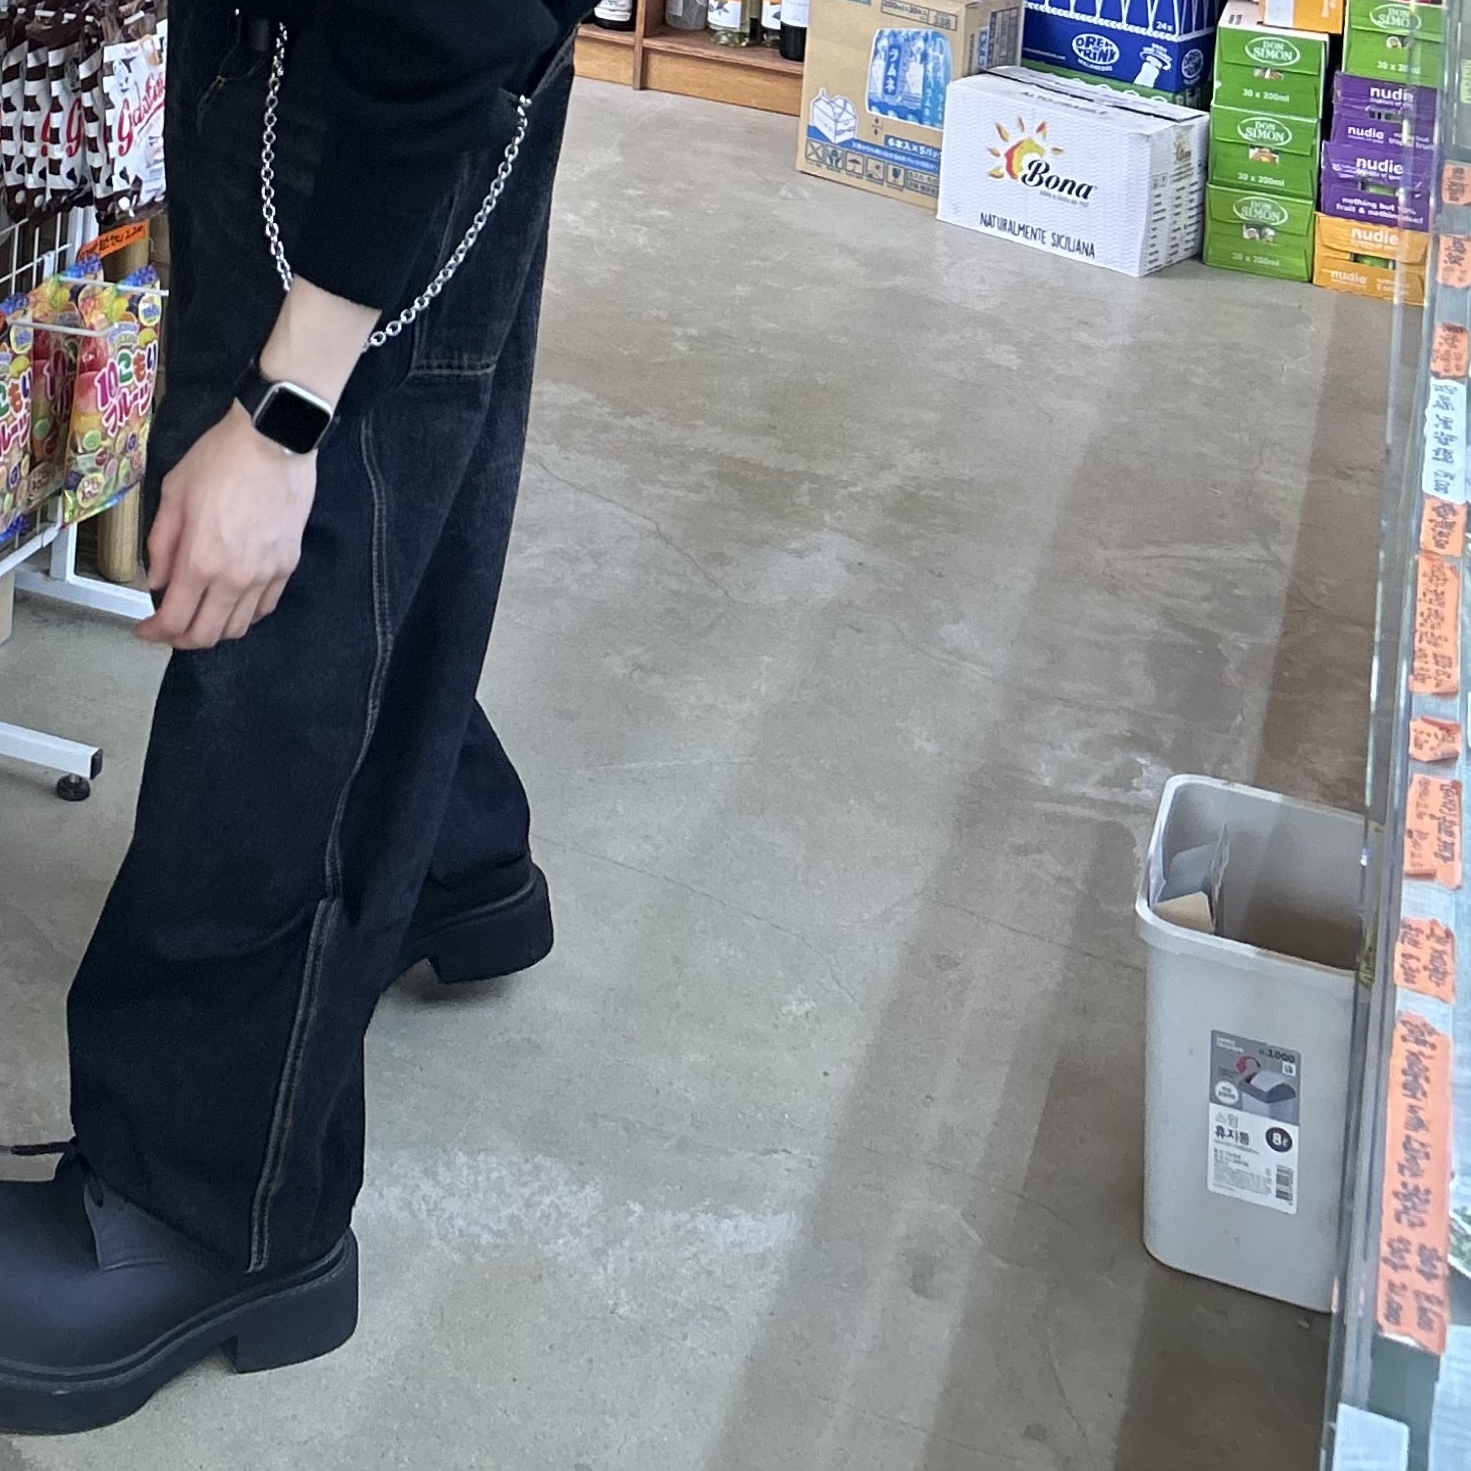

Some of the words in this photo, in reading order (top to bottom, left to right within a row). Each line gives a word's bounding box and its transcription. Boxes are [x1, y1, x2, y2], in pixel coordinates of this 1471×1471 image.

[1389, 4, 1410, 17] DON
[1156, 21, 1173, 32] 24x
[1263, 39, 1283, 51] DON
[884, 46, 900, 96] ラムネ
[1255, 118, 1275, 130] DON
[1348, 125, 1384, 140] nudie
[1356, 155, 1404, 175] nudie
[1021, 158, 1097, 201] Bona
[1250, 197, 1272, 209] DON
[1336, 202, 1358, 214] fruit
[1342, 197, 1378, 211] nothing
[1380, 201, 1395, 213] but
[979, 211, 1048, 247] NATURALMENTE
[1051, 230, 1097, 259] SICILIANA
[1351, 227, 1401, 245] nudie
[1330, 269, 1367, 285] nudie
